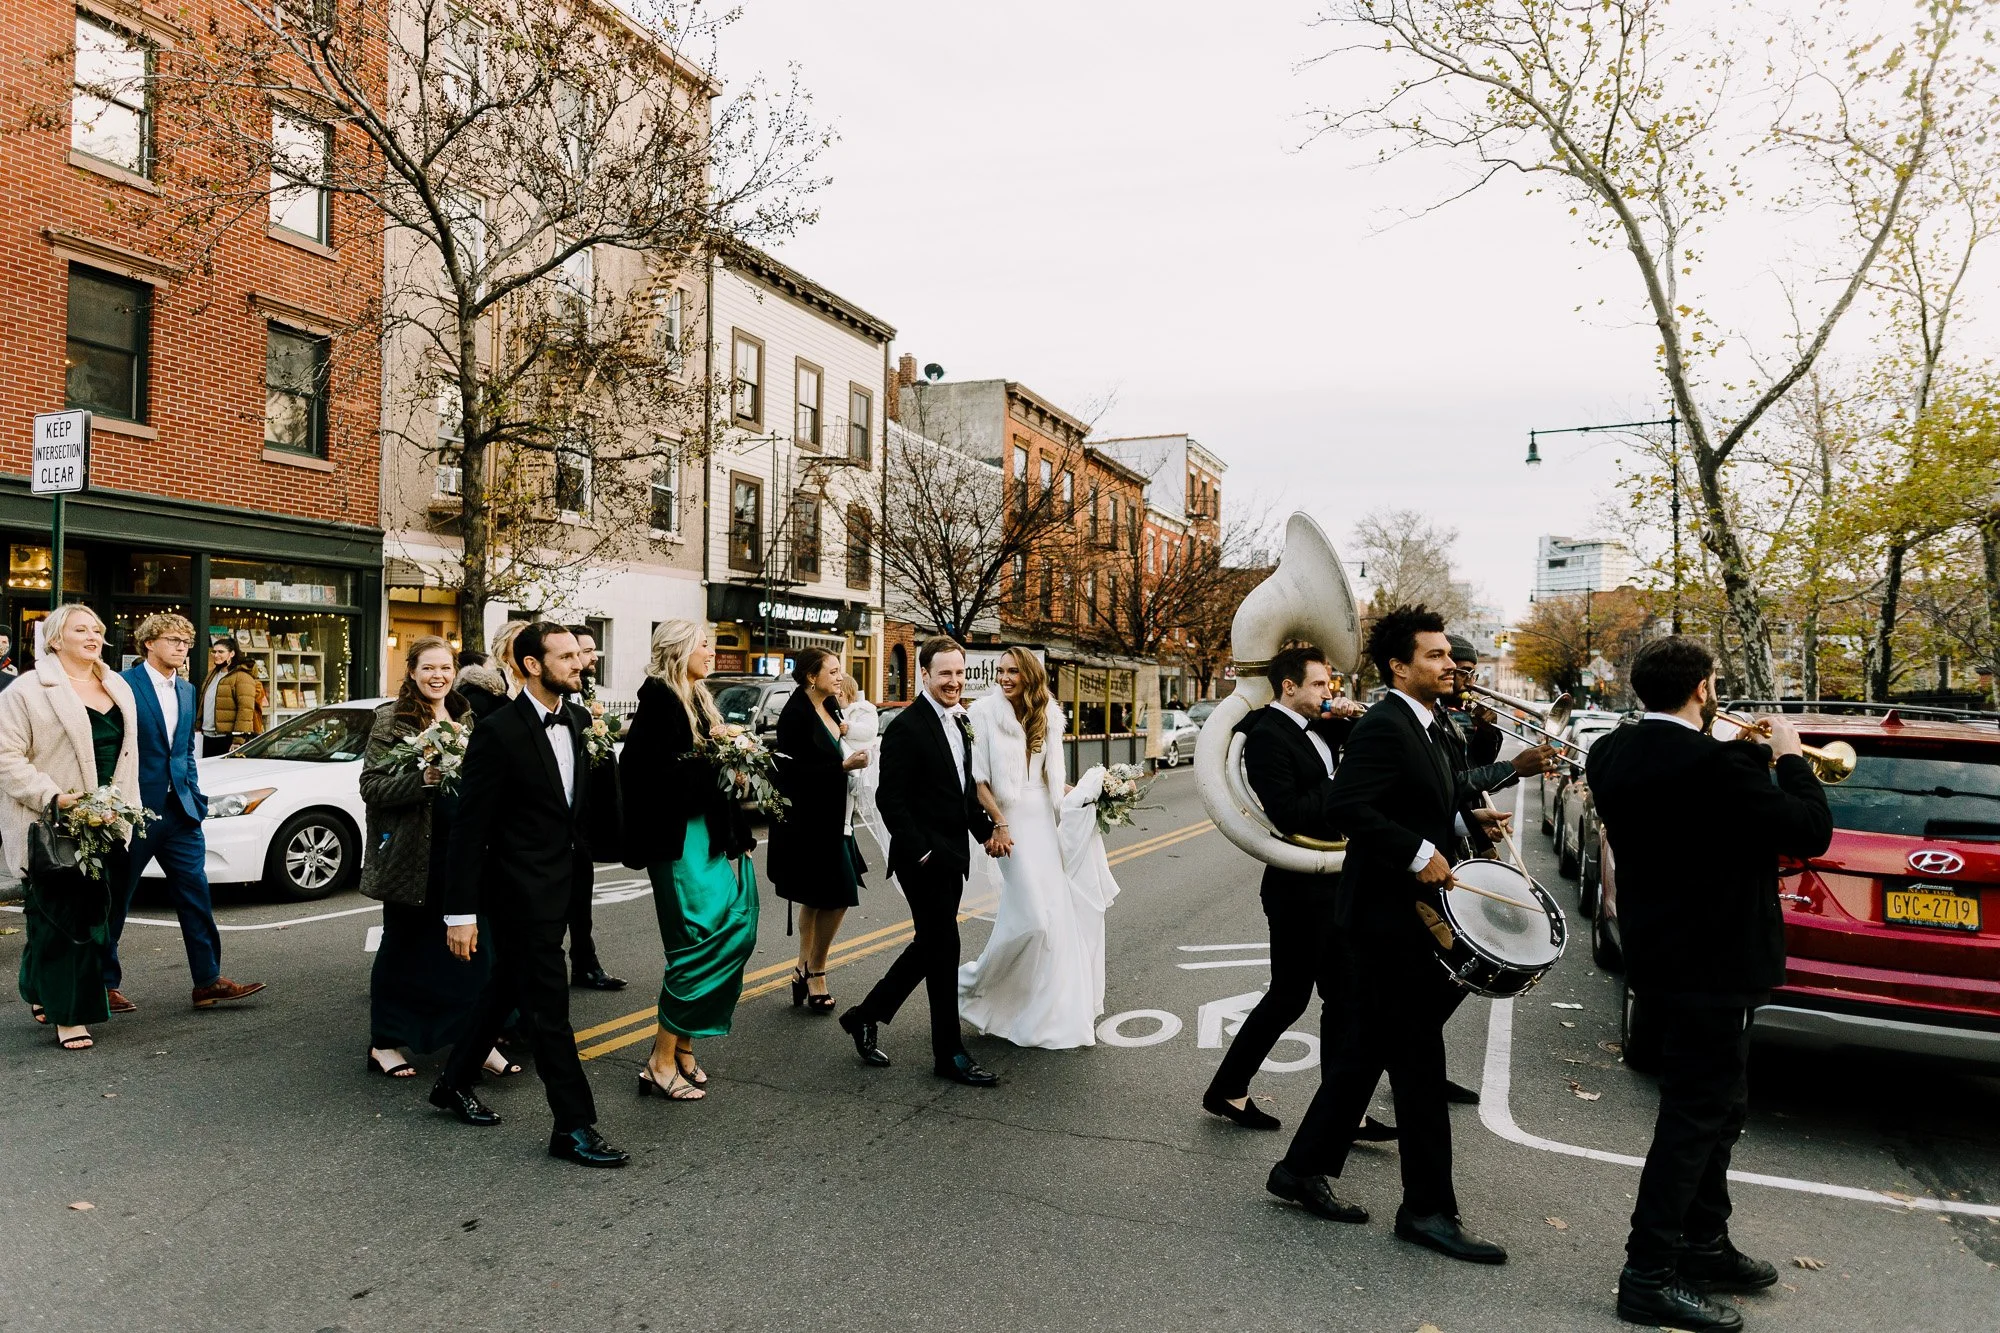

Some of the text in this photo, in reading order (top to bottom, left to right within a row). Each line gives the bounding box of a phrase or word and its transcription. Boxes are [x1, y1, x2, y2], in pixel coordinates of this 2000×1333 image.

[46, 420, 72, 438] KEEP
[35, 443, 81, 461] INTERSECTION
[41, 465, 74, 484] CLEAR
[804, 607, 821, 623] DELI
[821, 608, 839, 624] CORP
